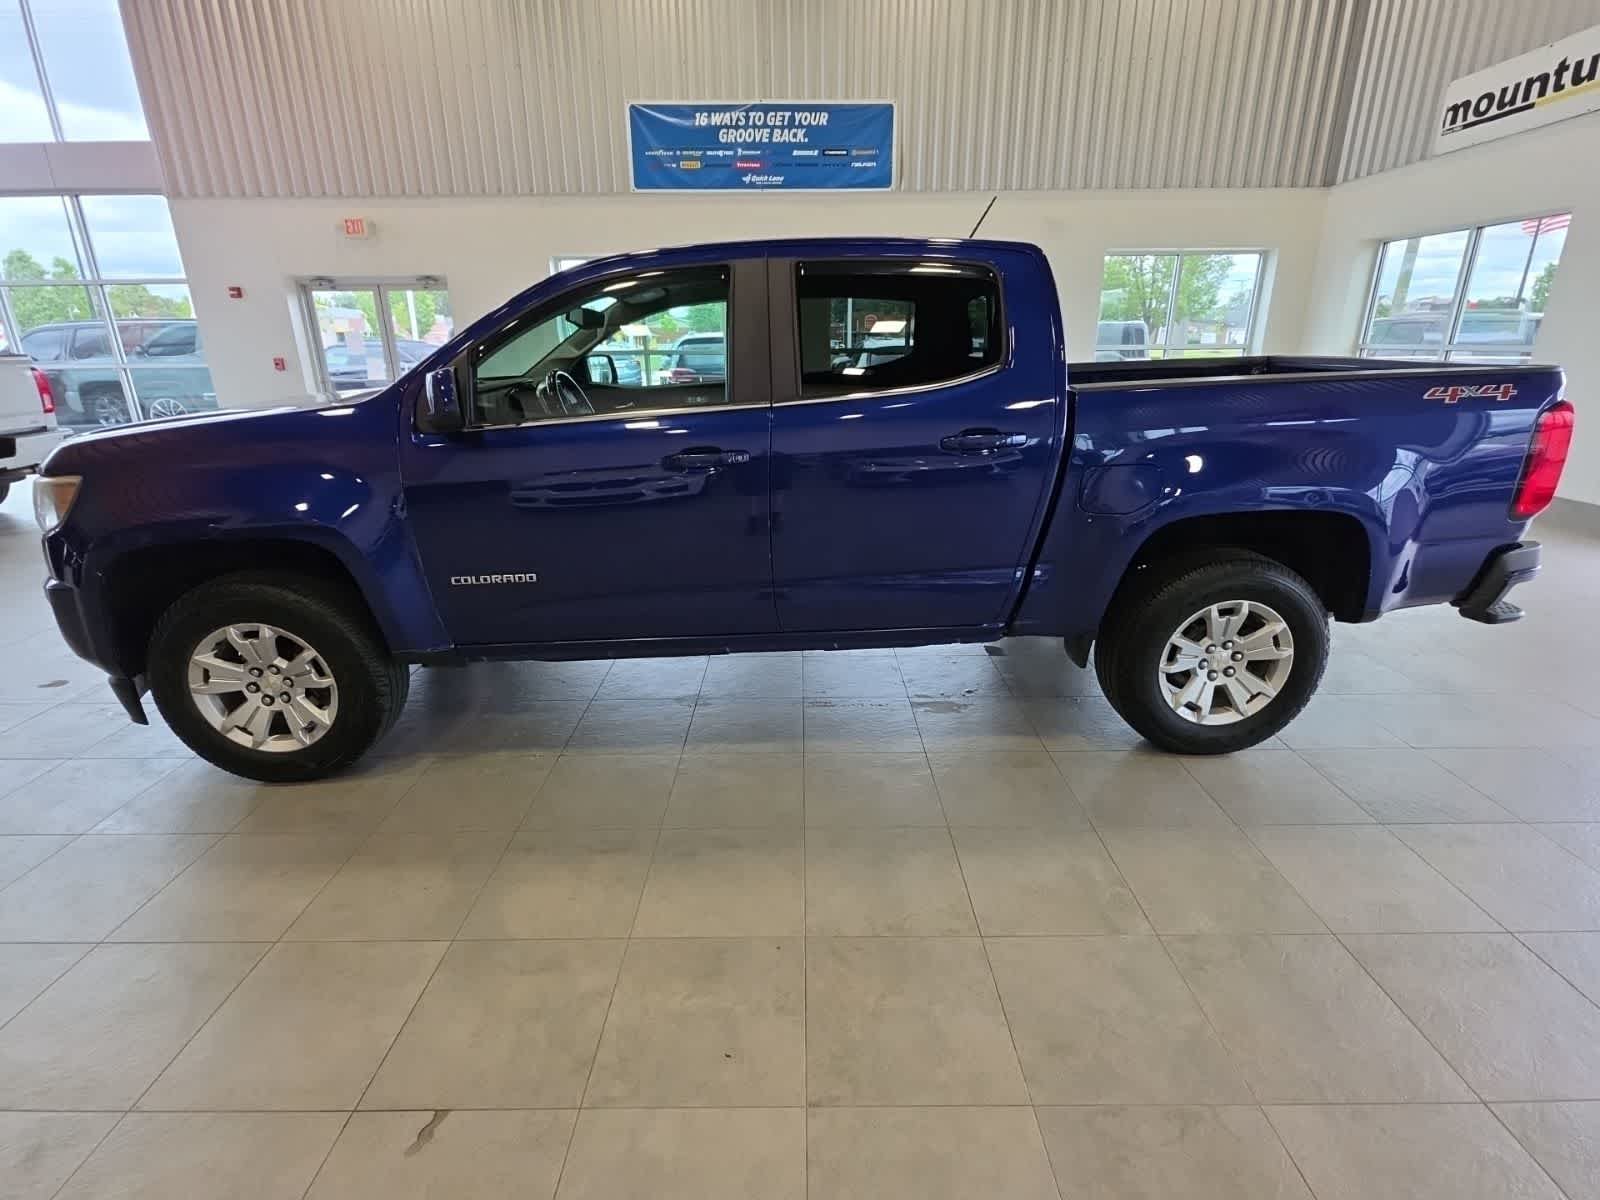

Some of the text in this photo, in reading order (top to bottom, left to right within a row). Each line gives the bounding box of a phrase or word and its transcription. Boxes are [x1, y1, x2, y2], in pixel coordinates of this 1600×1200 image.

[1442, 53, 1600, 127] mountu
[695, 112, 828, 126] 16 WAYS TO GET YOUR
[719, 128, 809, 143] GROOVE BACK.
[751, 174, 785, 182] Quick Lane
[345, 218, 364, 235] EXIT
[451, 573, 537, 585] COLORADO
